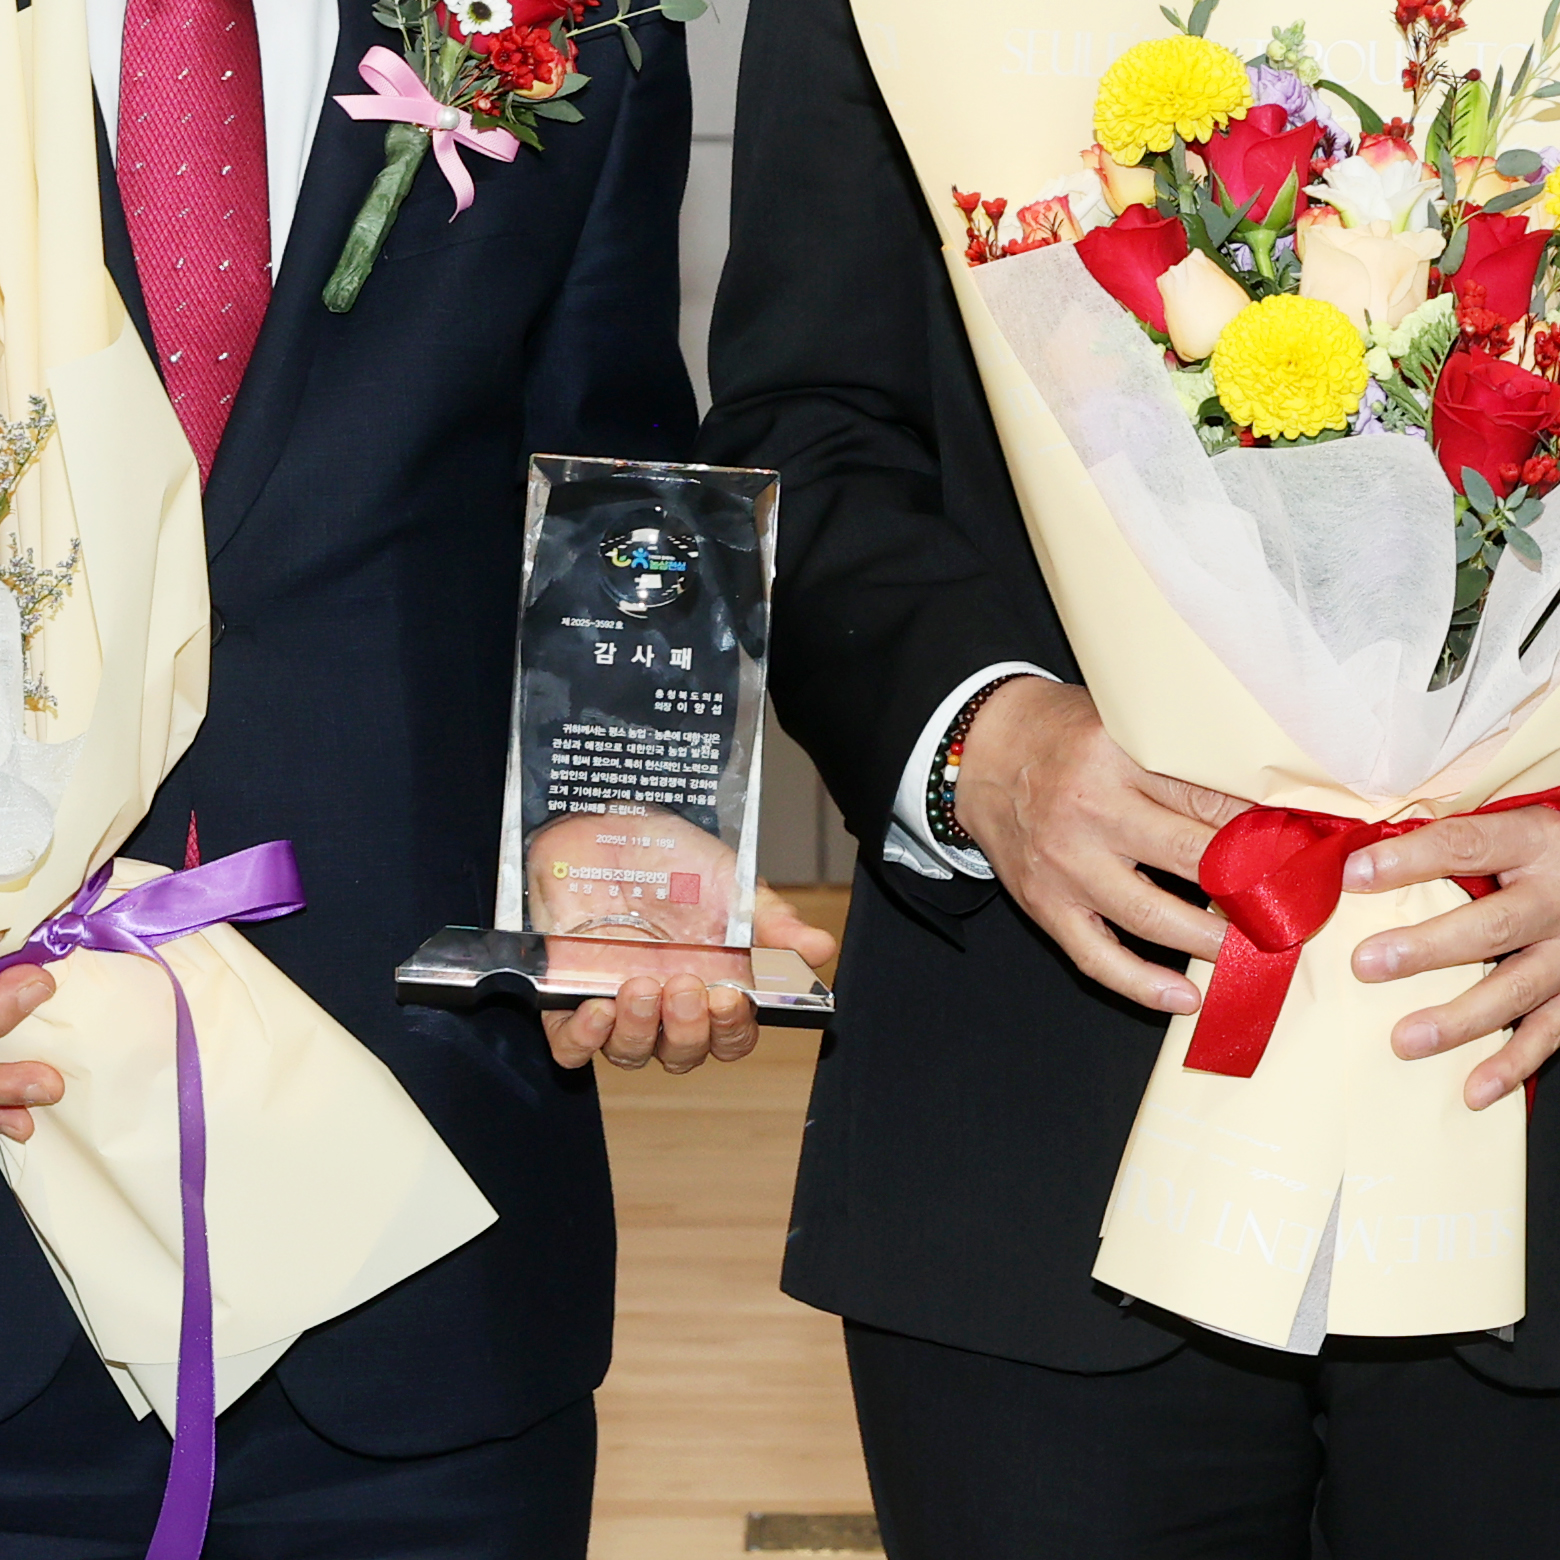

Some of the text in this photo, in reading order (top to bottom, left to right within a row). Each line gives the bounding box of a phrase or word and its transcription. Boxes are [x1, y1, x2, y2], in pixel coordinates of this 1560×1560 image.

[654, 702, 671, 712] 의장
[609, 727, 626, 737] 평소
[552, 738, 581, 750] 관심과
[627, 743, 664, 755] 대한민국
[668, 746, 687, 757] 농업
[551, 754, 570, 765] 위해
[624, 758, 642, 769] 특히
[682, 762, 718, 774] 노력으로
[550, 769, 587, 781] 농업인의
[548, 785, 568, 796] 크게
[570, 801, 606, 814] 감사패를
